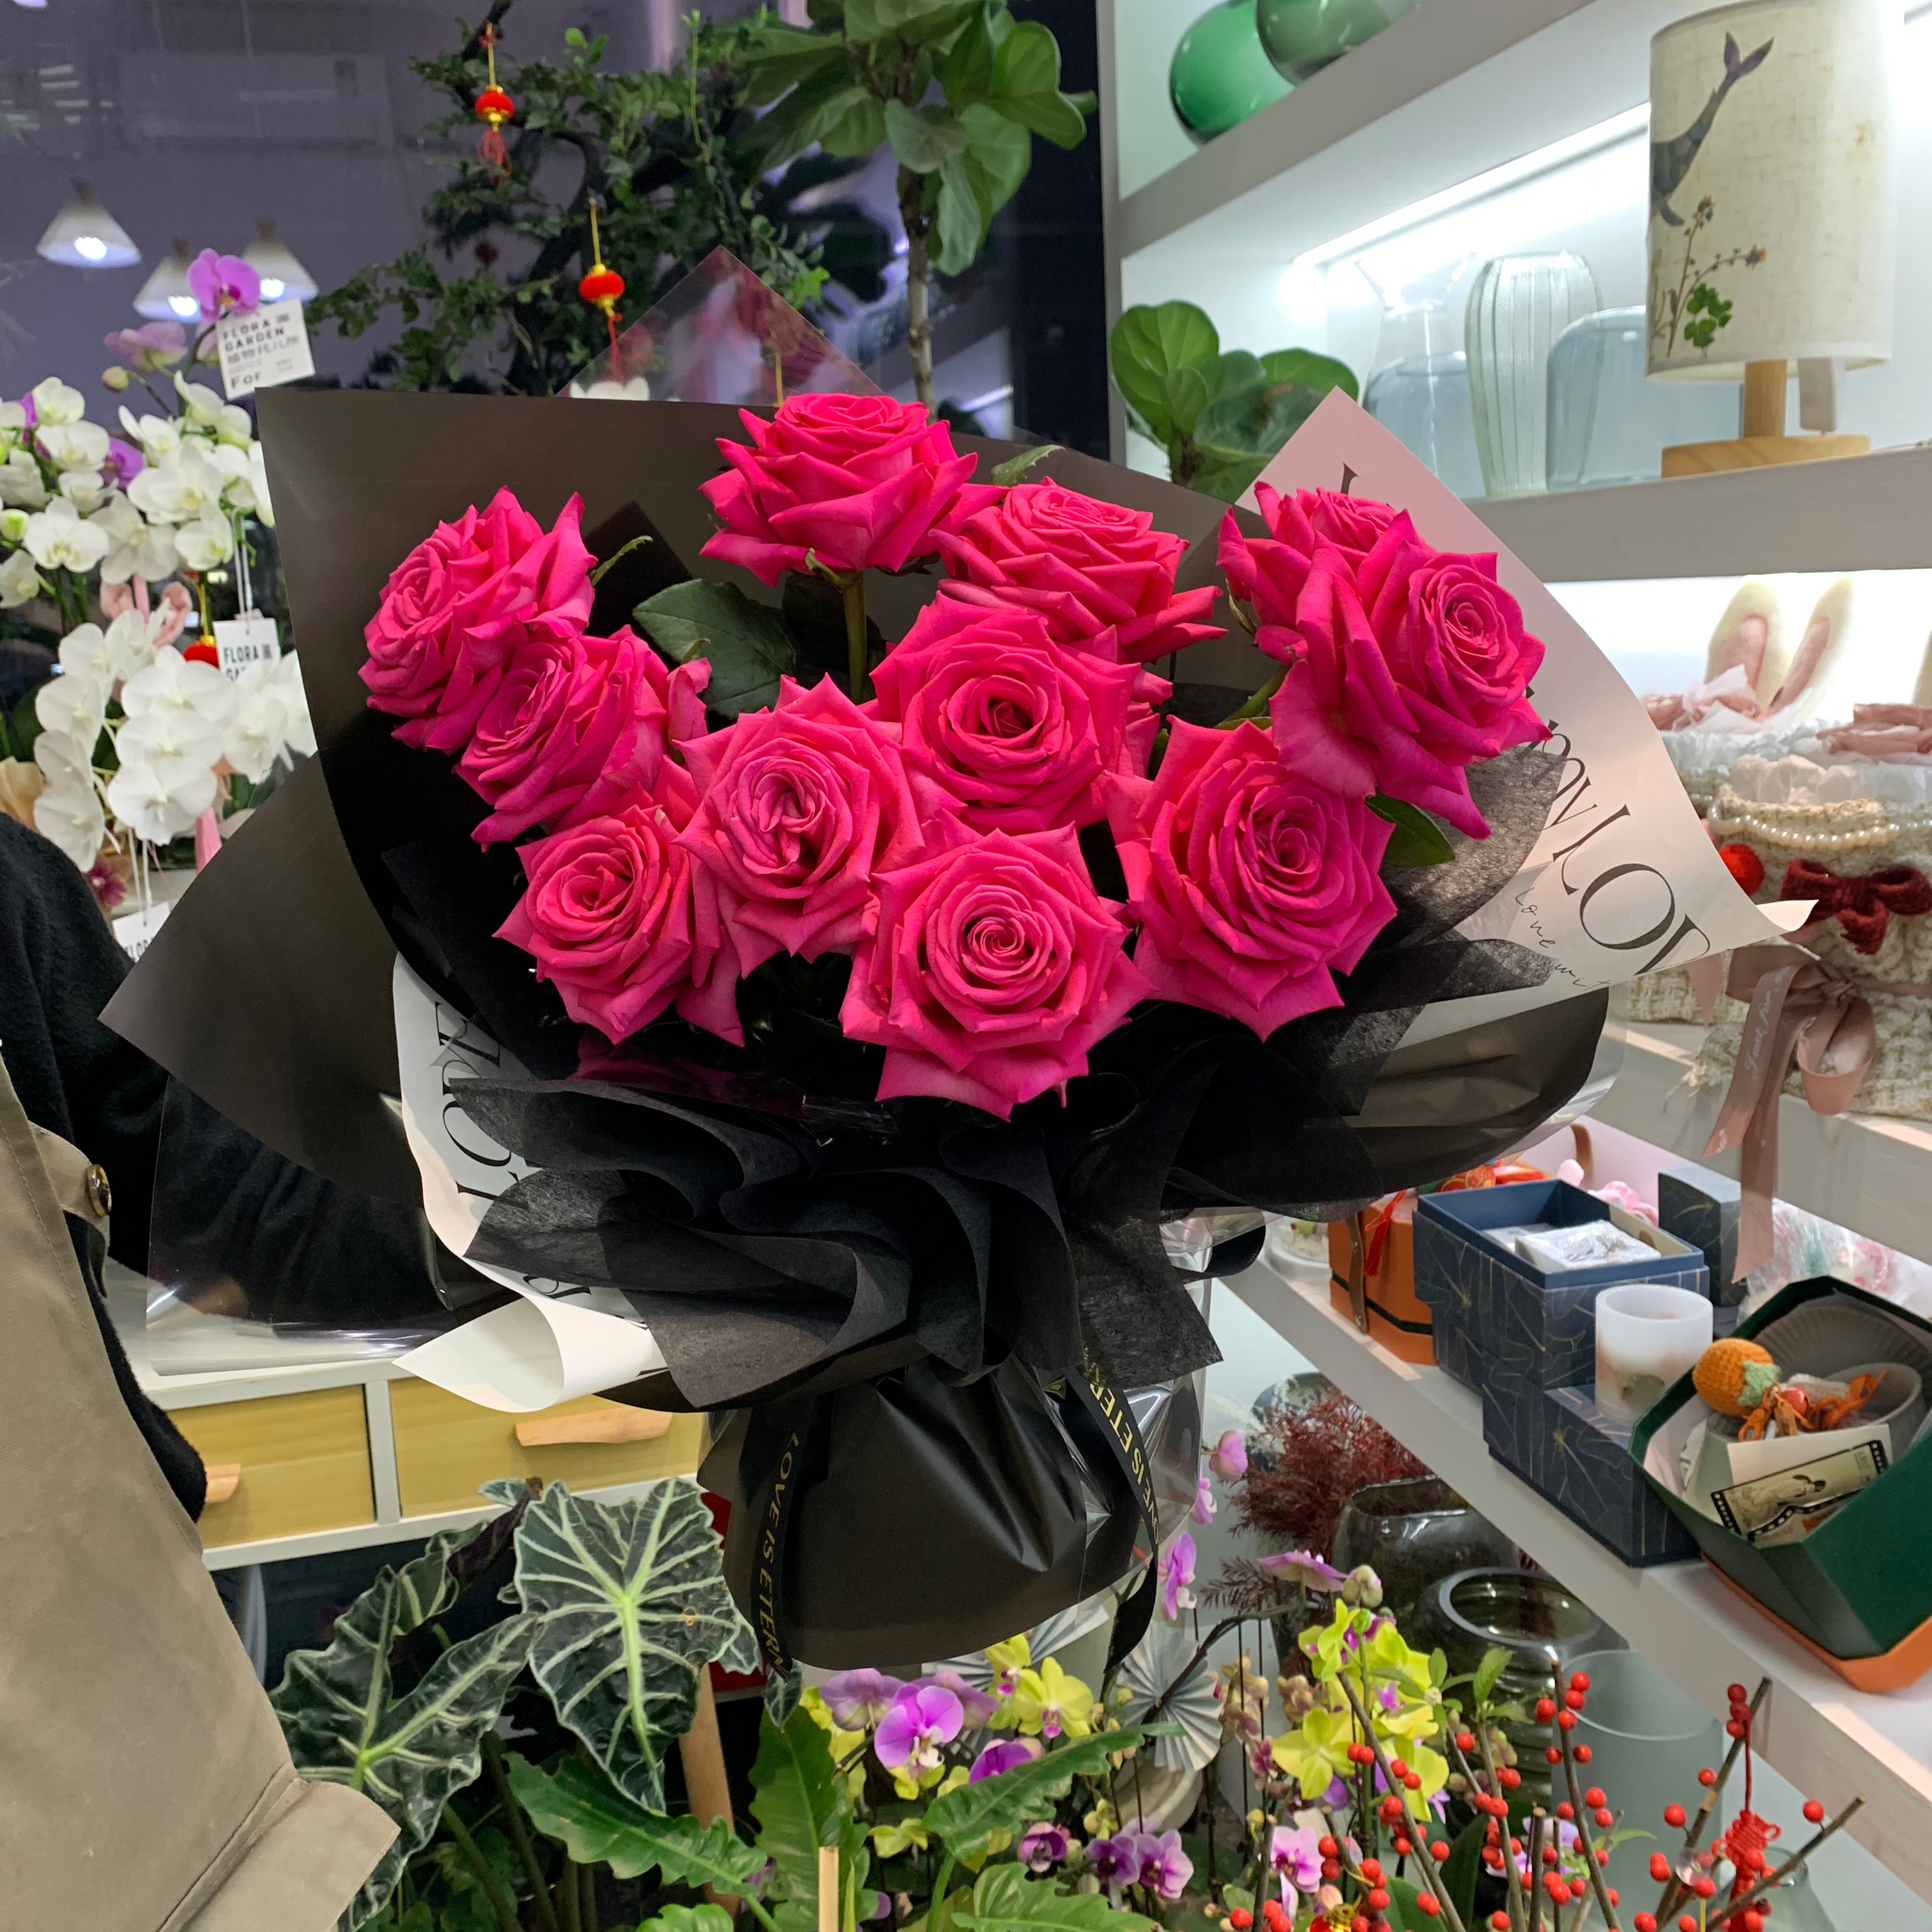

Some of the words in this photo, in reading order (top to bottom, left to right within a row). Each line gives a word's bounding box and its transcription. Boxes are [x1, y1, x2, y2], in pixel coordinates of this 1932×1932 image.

[222, 318, 270, 340] FLORA
[225, 326, 284, 352] GARDEN
[231, 371, 262, 389] For
[224, 644, 259, 663] FLORA
[1131, 1448, 1144, 1485] IS
[769, 1432, 799, 1528] LOVE
[763, 1529, 775, 1563] IS
